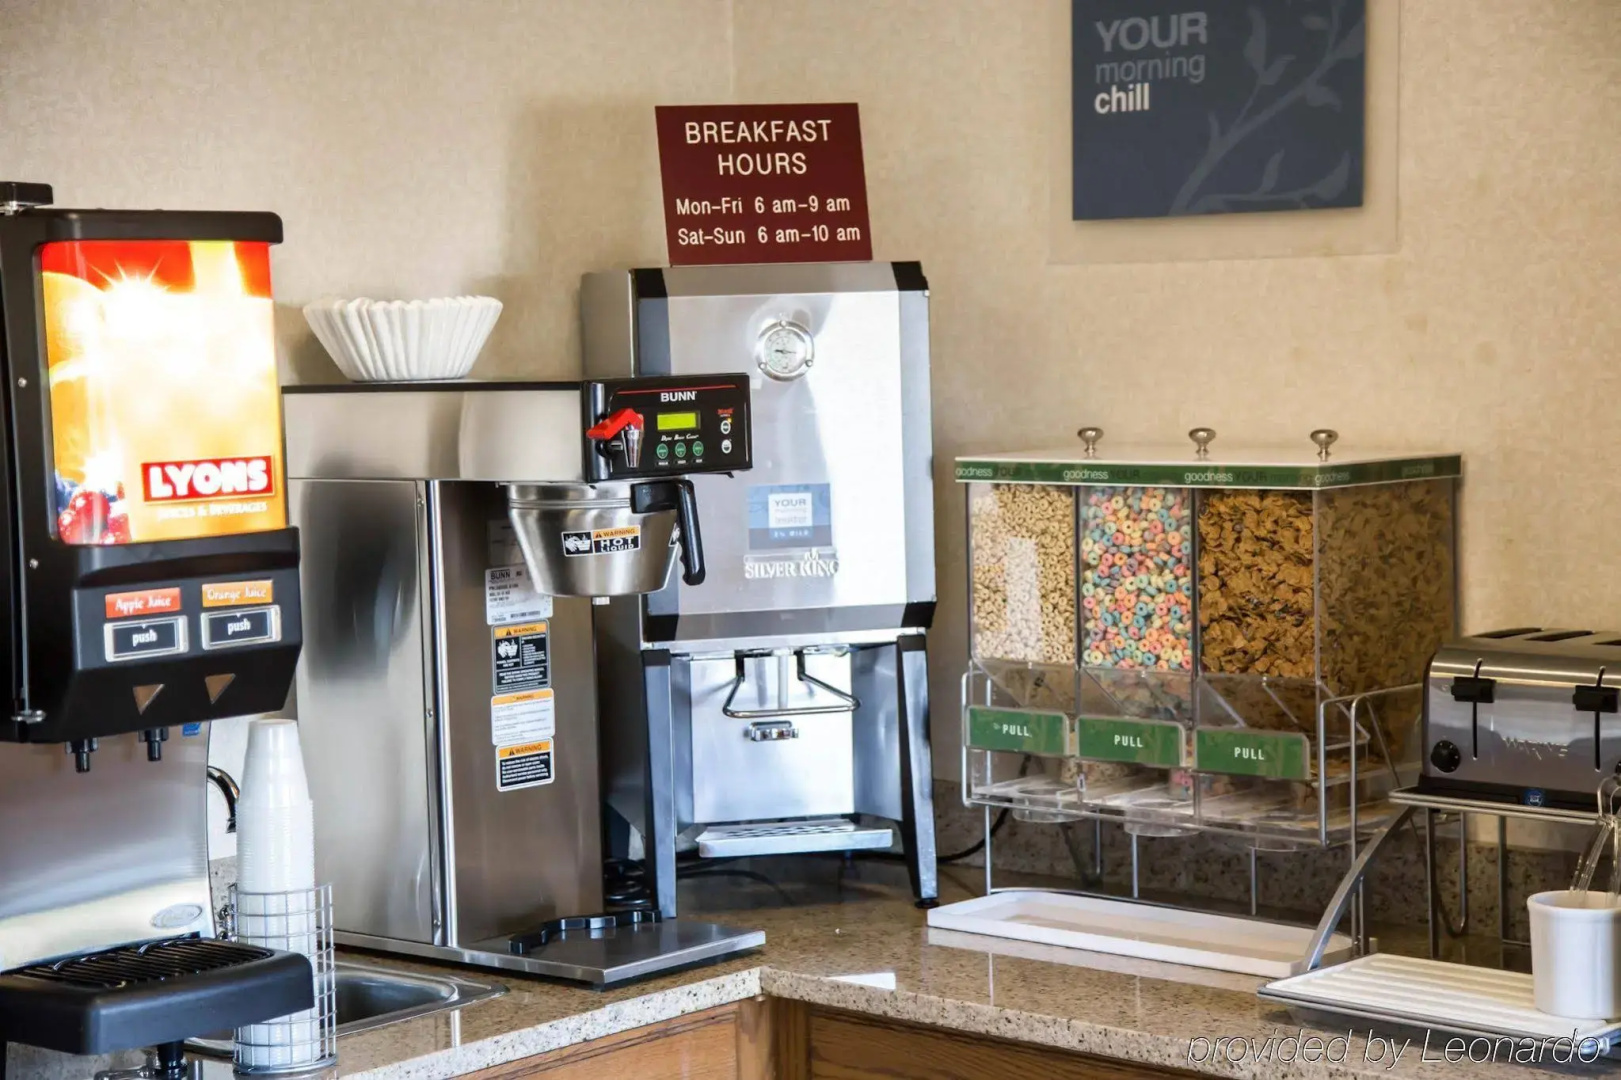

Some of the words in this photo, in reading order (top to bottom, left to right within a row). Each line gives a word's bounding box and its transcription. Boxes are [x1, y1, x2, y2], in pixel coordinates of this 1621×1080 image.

[1095, 11, 1207, 52] YOUR
[1095, 51, 1206, 84] morning
[1094, 82, 1150, 114] chill
[685, 119, 832, 144] BREAKFAST
[718, 152, 807, 176] HOURS
[676, 197, 743, 215] Mon-Fri
[754, 196, 764, 213] 6
[826, 197, 851, 212] am
[678, 227, 746, 245] Sat-Sun
[757, 226, 768, 244] 6
[836, 226, 861, 241] am
[660, 391, 696, 402] BUNN
[149, 459, 269, 498] LYONS
[955, 466, 993, 477] oodness
[1063, 469, 1109, 481] goodness
[1184, 470, 1233, 484] goodness
[774, 498, 807, 507] YOUR
[603, 528, 635, 537] WARNING
[600, 536, 634, 547] HOT
[600, 544, 634, 553] LIQUID
[490, 570, 511, 580] BUNN
[745, 561, 797, 579] SILVER
[207, 588, 241, 603] Orange
[244, 586, 267, 599] Juice
[115, 595, 144, 613] Apple
[147, 594, 171, 608] Juice
[227, 619, 251, 636] push
[132, 630, 158, 647] push
[1002, 724, 1030, 737] PULL
[515, 744, 542, 754] WARNING
[1114, 735, 1143, 748] PULL
[1234, 747, 1265, 760] PULL
